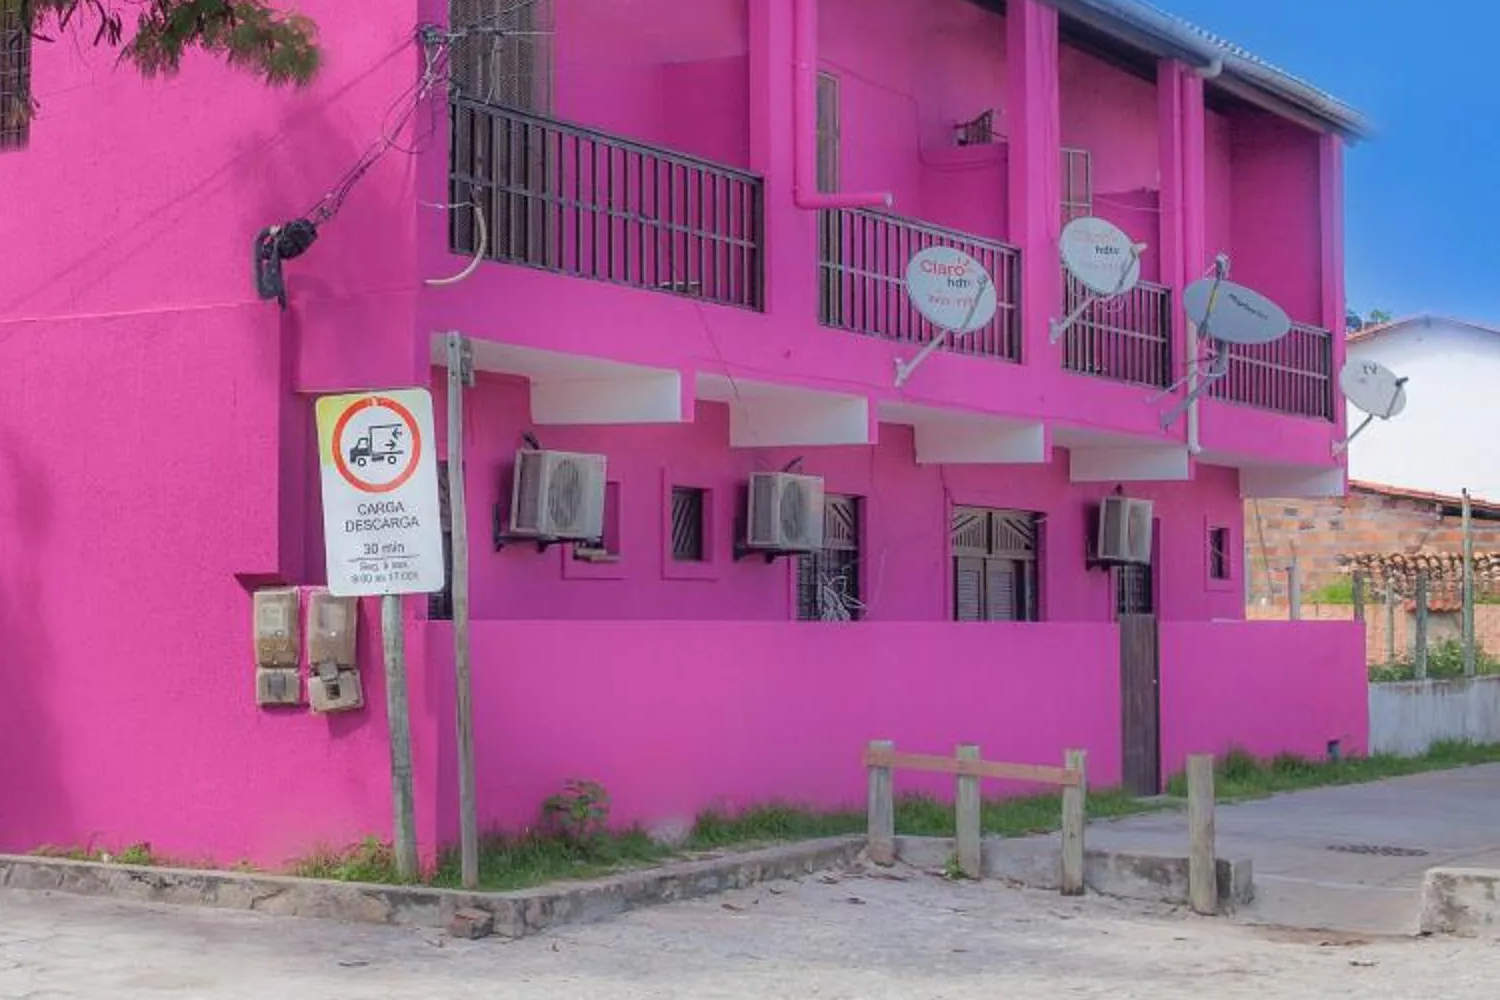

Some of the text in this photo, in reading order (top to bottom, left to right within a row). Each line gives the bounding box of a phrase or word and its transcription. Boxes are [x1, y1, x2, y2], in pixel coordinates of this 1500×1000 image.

[920, 259, 965, 276] Claro
[357, 501, 405, 516] CARGA
[345, 516, 421, 533] DESCARGA
[363, 541, 405, 555] 30 min
